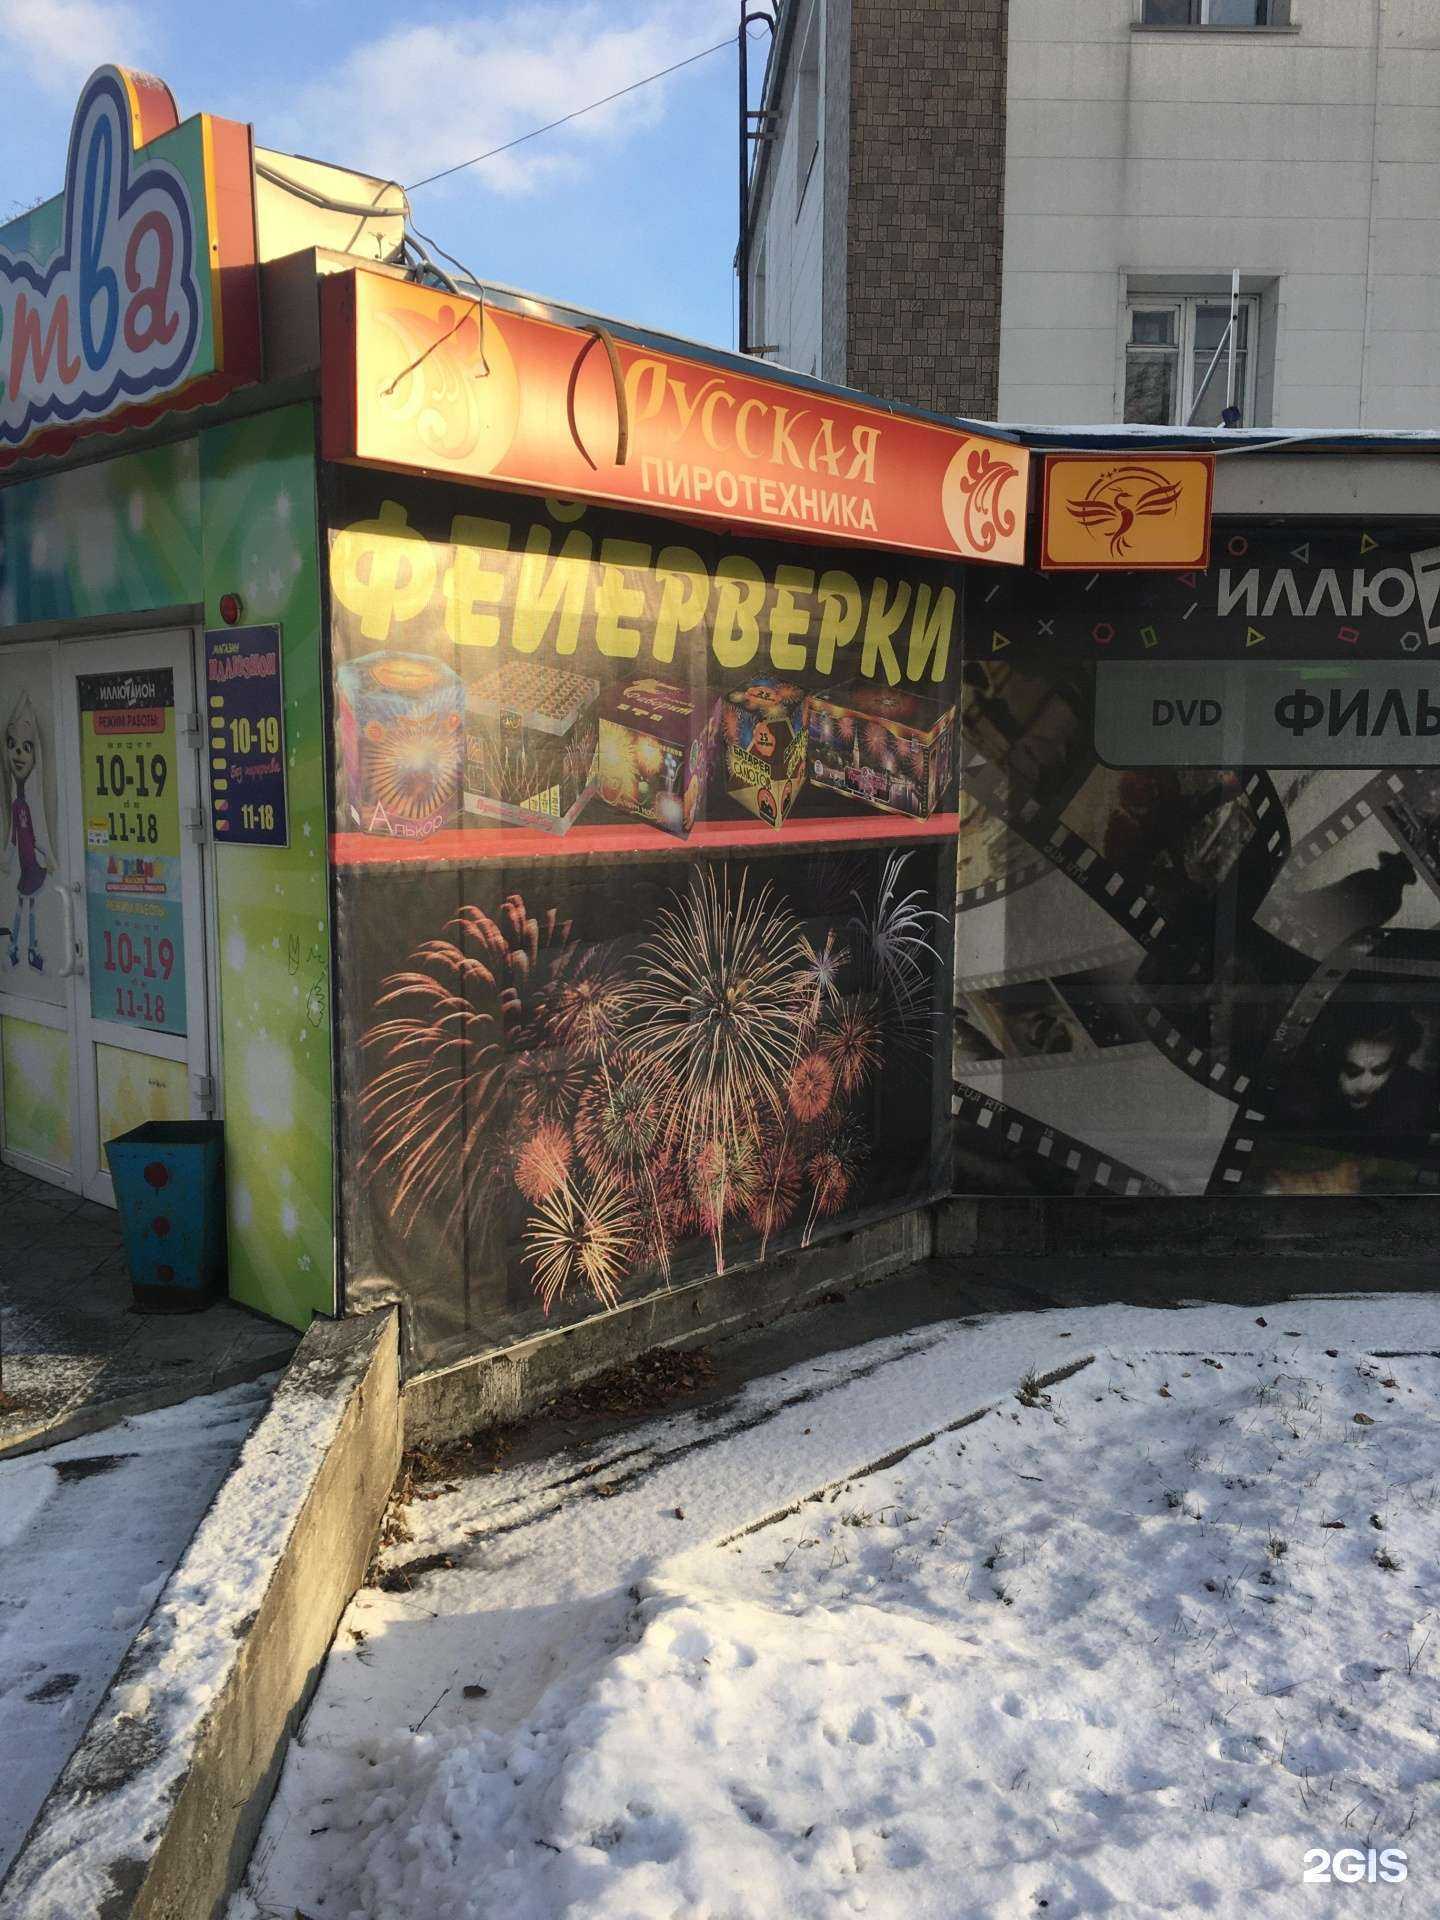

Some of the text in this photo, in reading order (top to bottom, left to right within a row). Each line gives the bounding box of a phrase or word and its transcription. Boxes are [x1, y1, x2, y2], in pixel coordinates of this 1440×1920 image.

[0, 113, 180, 402] тва
[640, 456, 878, 532] ПИРОТЕХНИКА
[330, 499, 957, 687] ФЕЙЕРВЕРКИ
[1152, 700, 1222, 727] DVD
[230, 717, 279, 753] 10-19
[96, 754, 167, 797] 10-19
[108, 812, 158, 843] 11-18
[241, 804, 274, 830] 11-18
[104, 931, 174, 980] 10-19
[116, 987, 165, 1023] 11-18
